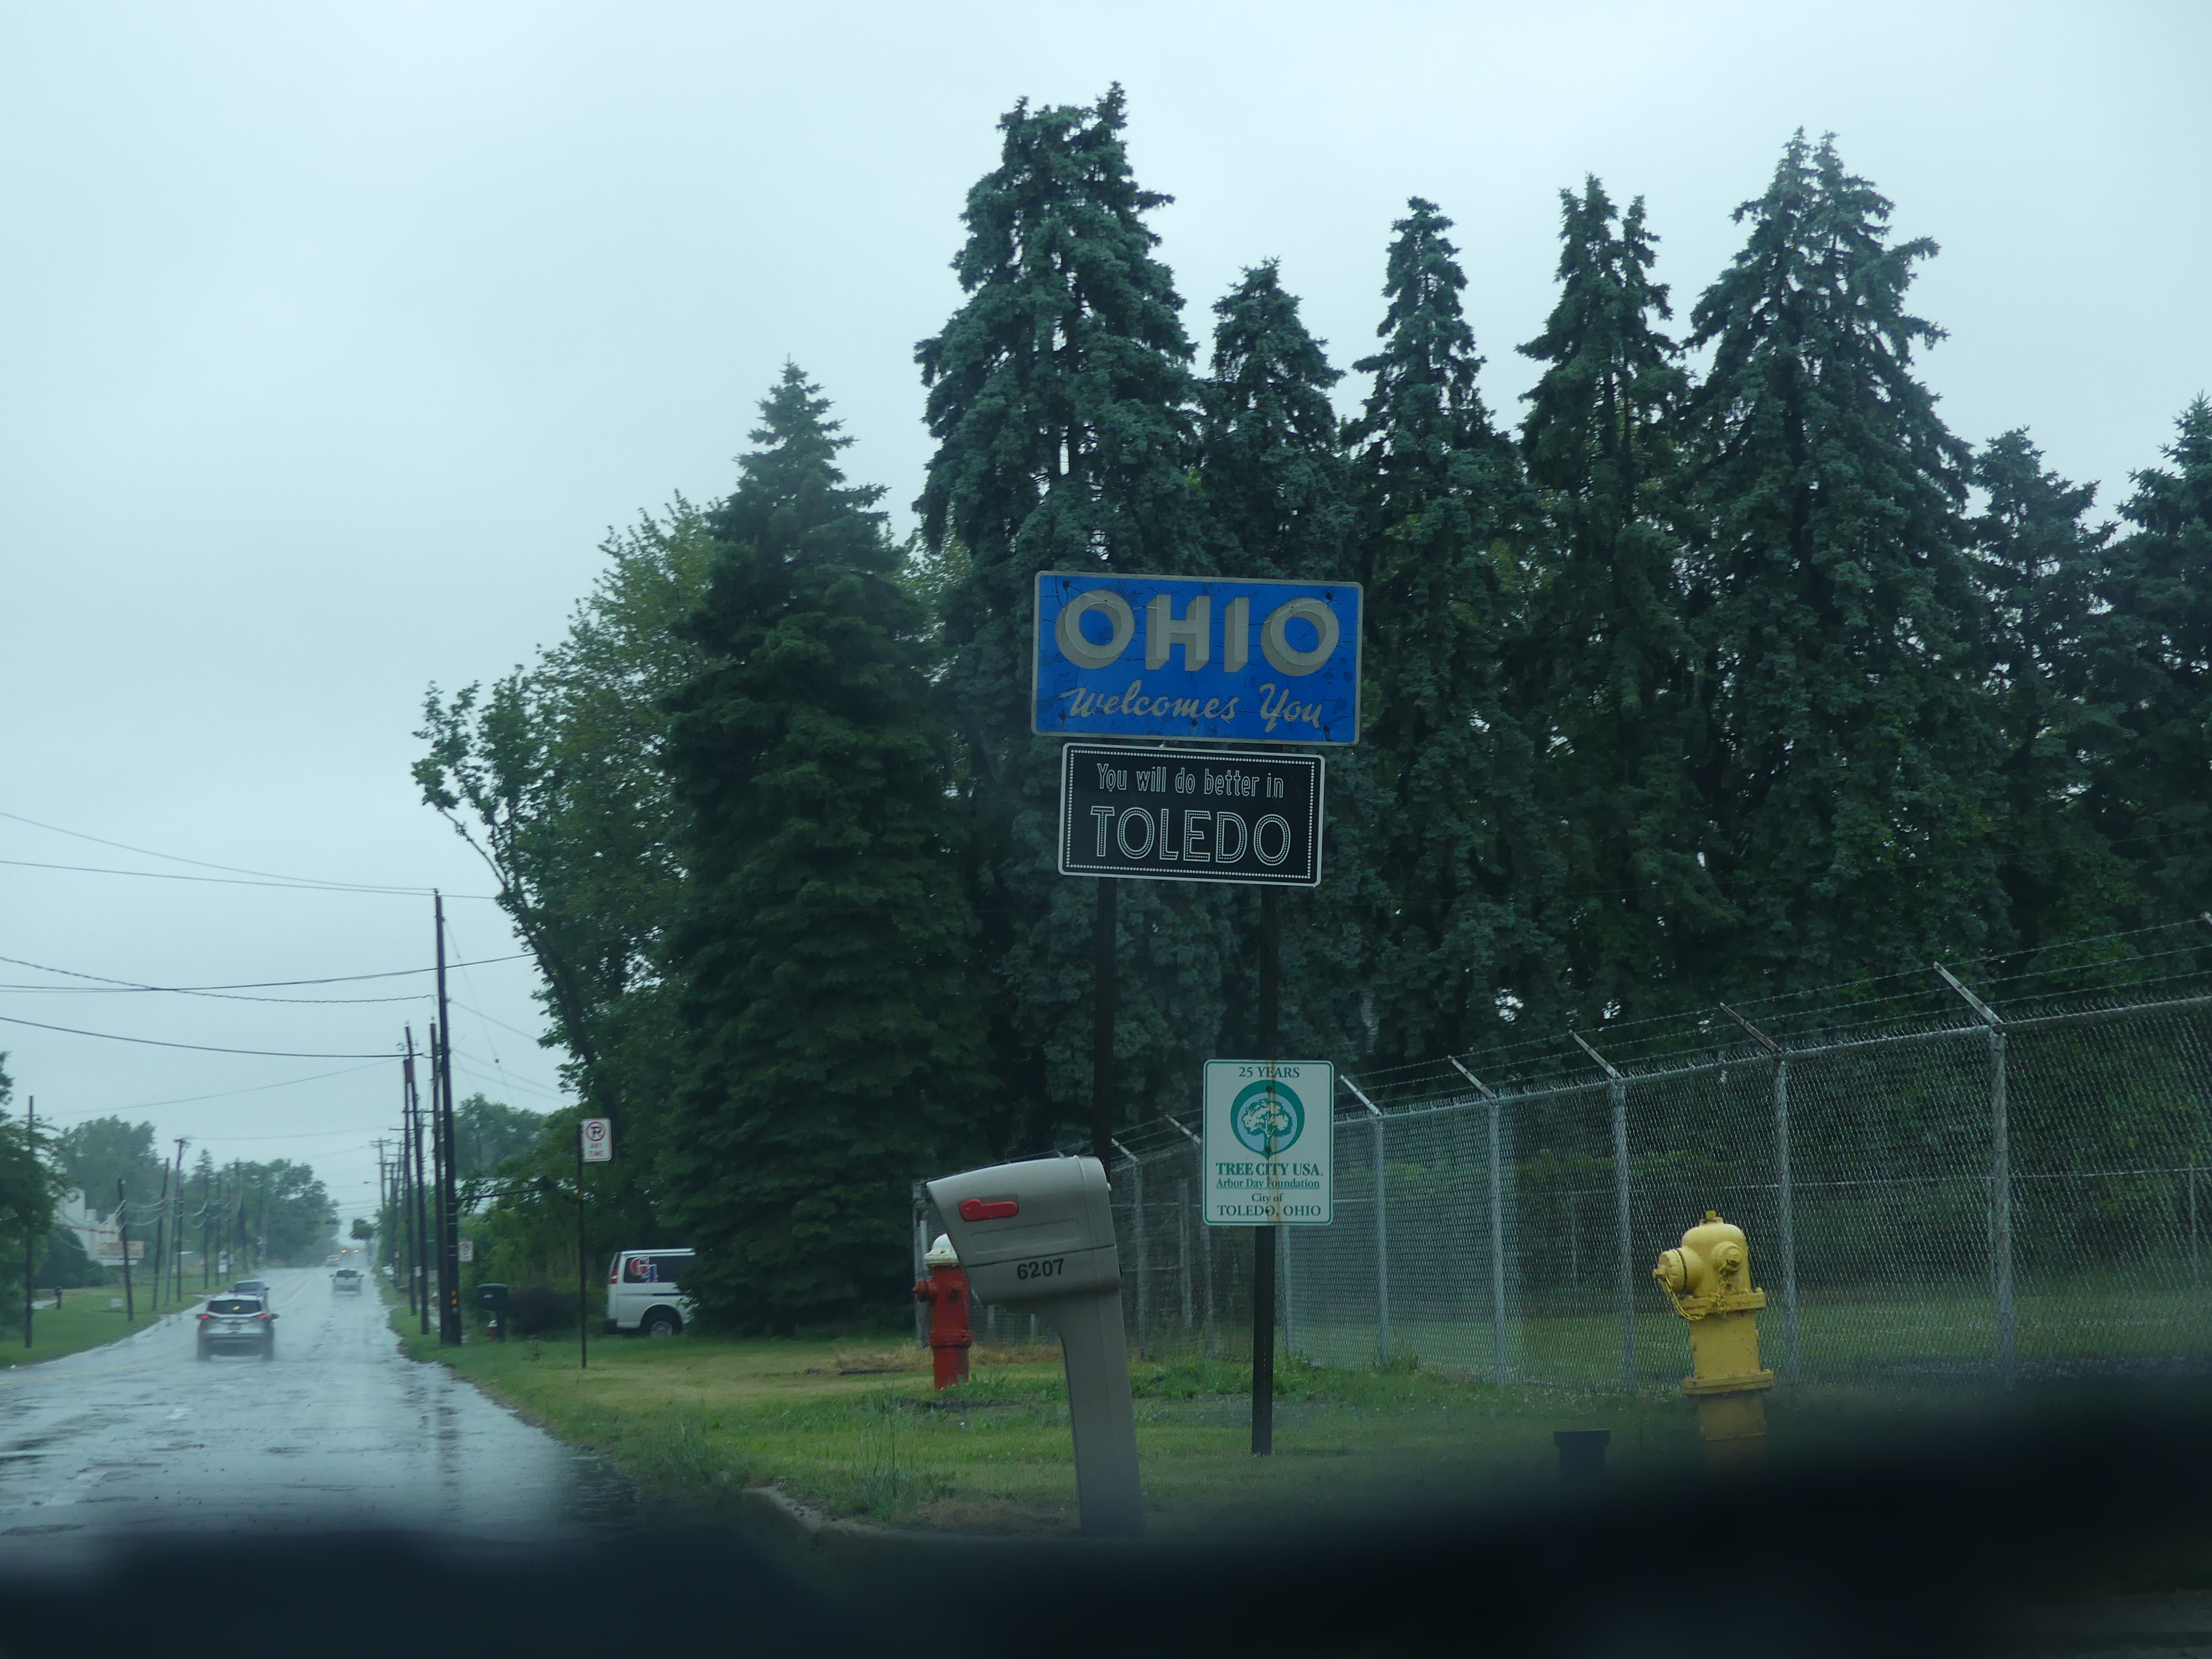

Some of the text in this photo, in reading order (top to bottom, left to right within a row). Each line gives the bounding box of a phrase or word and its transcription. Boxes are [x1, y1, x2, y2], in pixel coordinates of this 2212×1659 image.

[1055, 589, 1339, 676] OHIO
[1060, 679, 1323, 733] Welcomes You
[1097, 763, 1284, 798] You will do better in
[1091, 806, 1291, 866] TOLEDO
[1239, 1067, 1300, 1078] 25 YEARS
[1216, 1162, 1253, 1176] TREE
[1255, 1162, 1289, 1176] CITY
[1217, 1178, 1319, 1190] Arbor Day Foundation
[1251, 1193, 1284, 1204] City of
[1217, 1205, 1321, 1217] TOLEDO, OHIO
[1017, 1258, 1064, 1280] 6207
